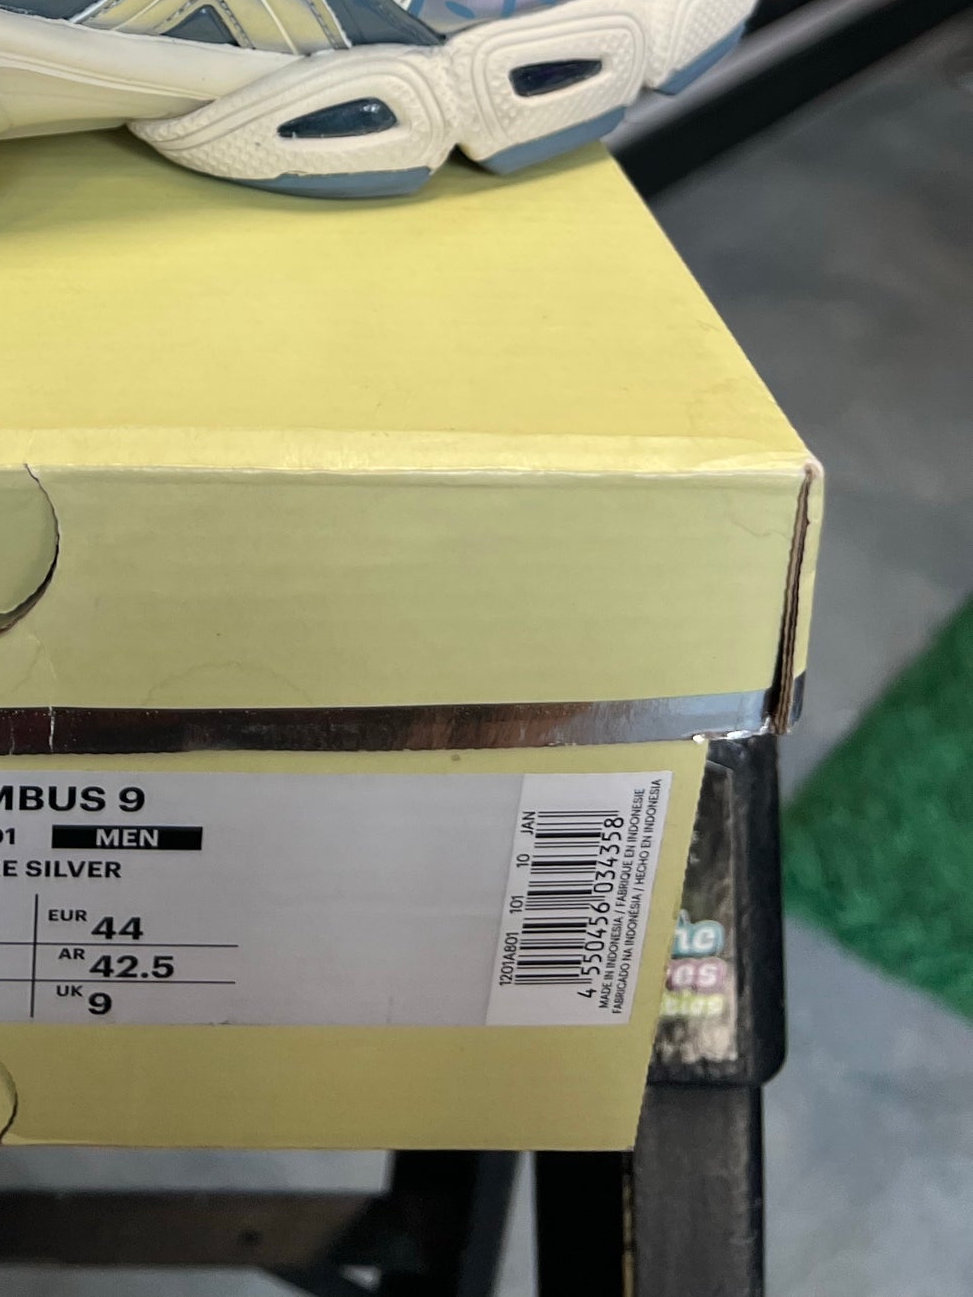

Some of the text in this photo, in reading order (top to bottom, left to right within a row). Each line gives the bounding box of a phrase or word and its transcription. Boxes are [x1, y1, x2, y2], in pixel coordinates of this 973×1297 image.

[118, 786, 146, 813] 9
[642, 779, 662, 834] INDONESIA
[95, 827, 159, 847] MEN
[641, 836, 652, 848] EN
[624, 845, 635, 859] EN
[25, 859, 122, 878] SILVER
[634, 850, 649, 885] HECHO
[499, 811, 536, 986] 1201A801 101 10 JAN
[47, 909, 88, 923] EUR
[90, 916, 144, 940] 44
[606, 916, 623, 969] INDONESIA
[58, 948, 85, 960] AR
[621, 949, 633, 963] NA
[89, 955, 175, 979] 42.5
[604, 970, 614, 981] IN
[56, 985, 83, 997] UK
[577, 989, 597, 998] 4
[598, 982, 613, 1008] MADE
[612, 963, 630, 1014] FABRICADO
[87, 992, 113, 1015] 9
